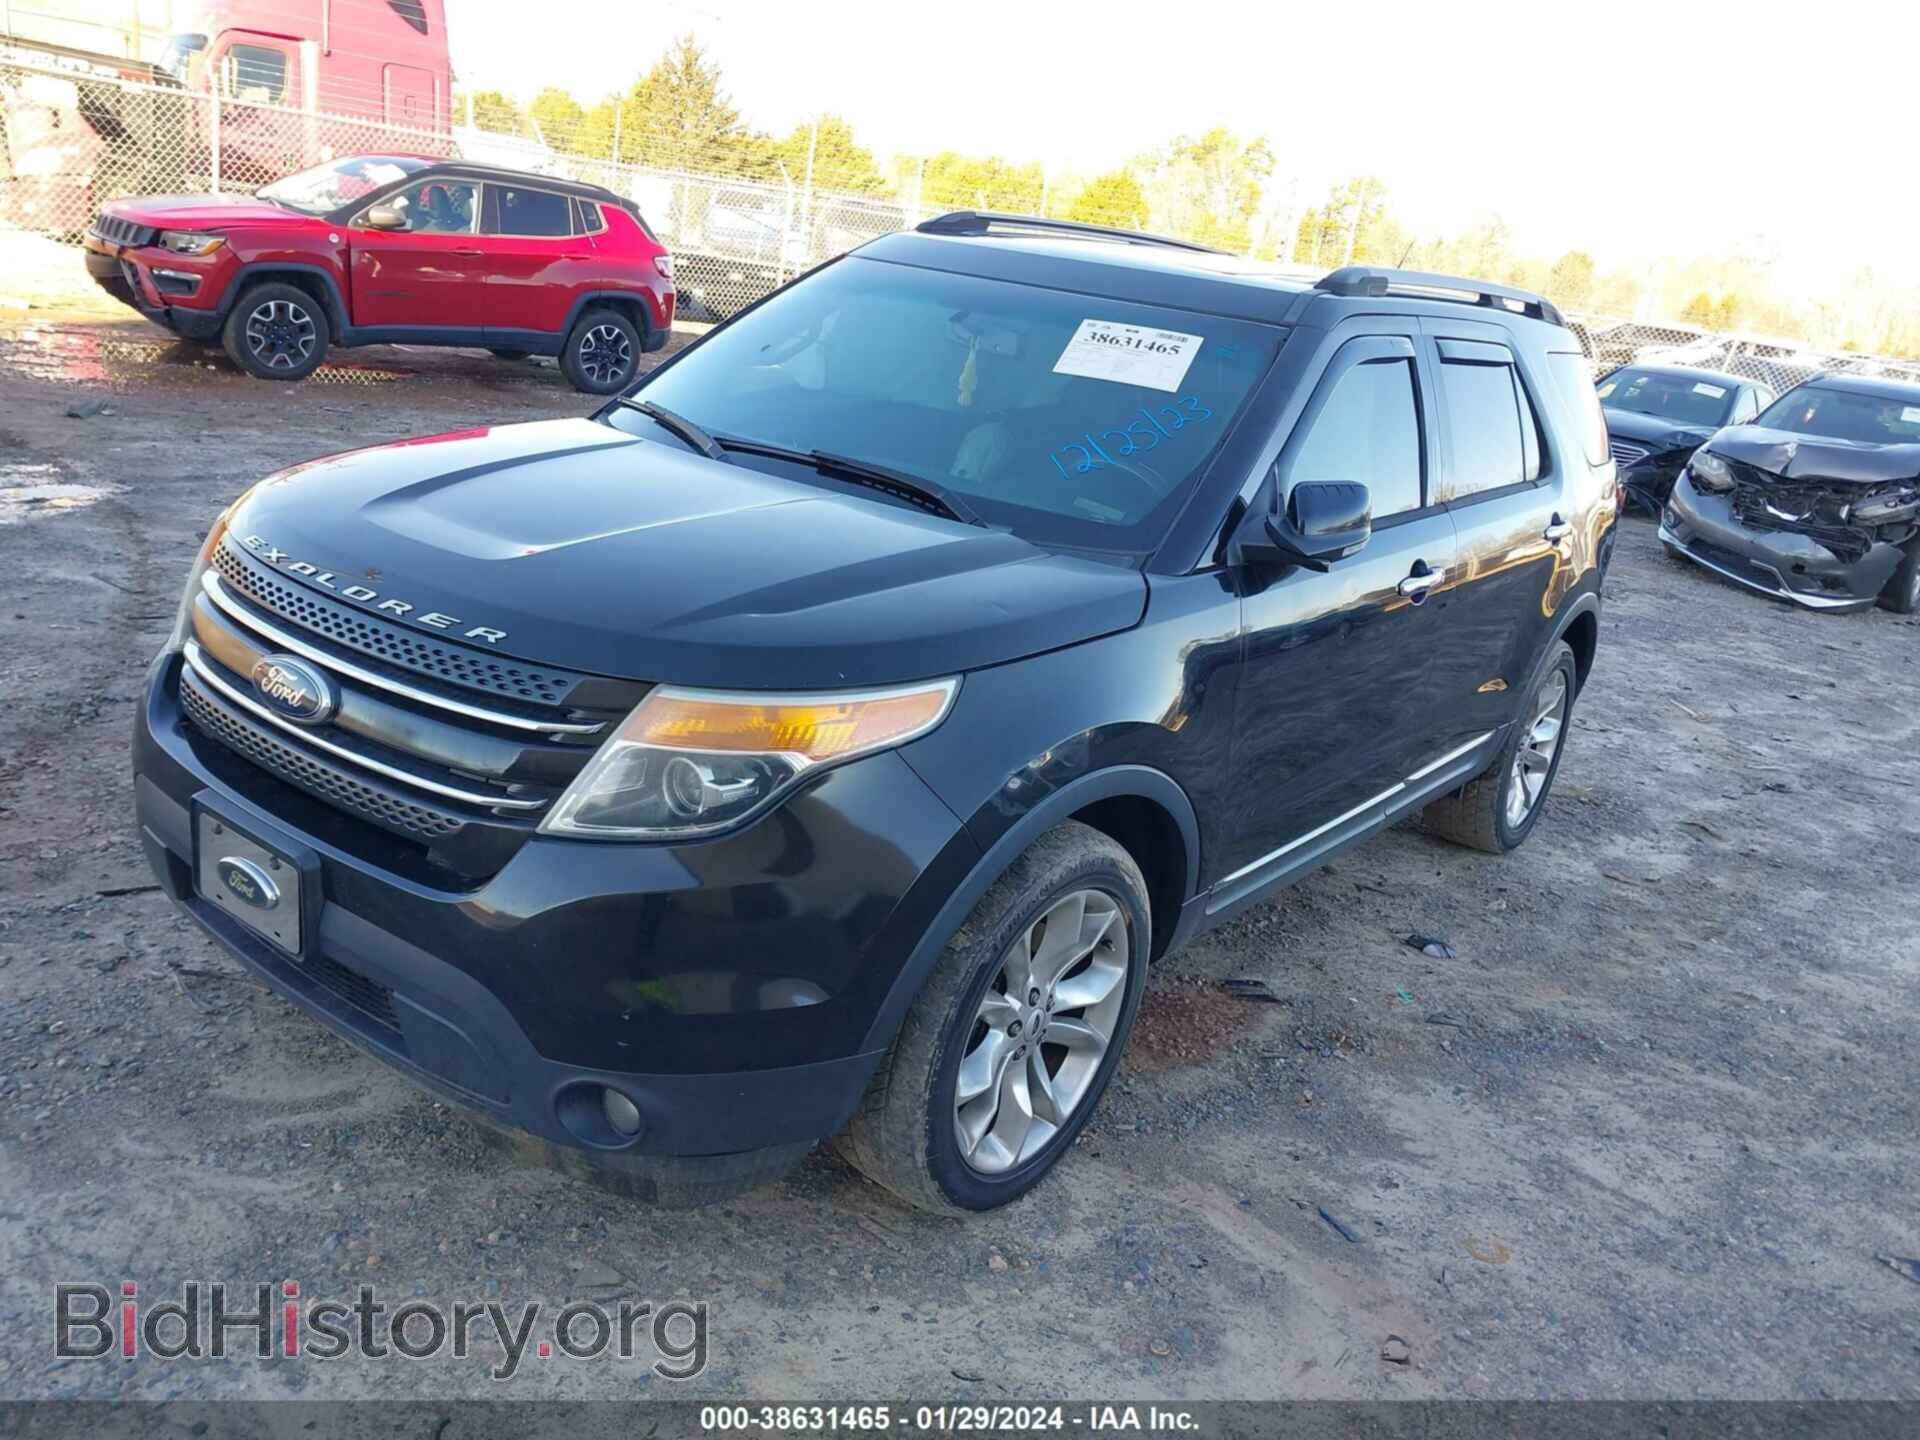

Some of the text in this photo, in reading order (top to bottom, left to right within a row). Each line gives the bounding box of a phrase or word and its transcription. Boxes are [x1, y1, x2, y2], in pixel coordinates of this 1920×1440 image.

[1084, 331, 1182, 356] 38631465
[1050, 396, 1213, 479] 12/25/23
[244, 534, 508, 643] EXPLORER
[260, 665, 305, 708] Ford
[228, 871, 254, 898] Ford
